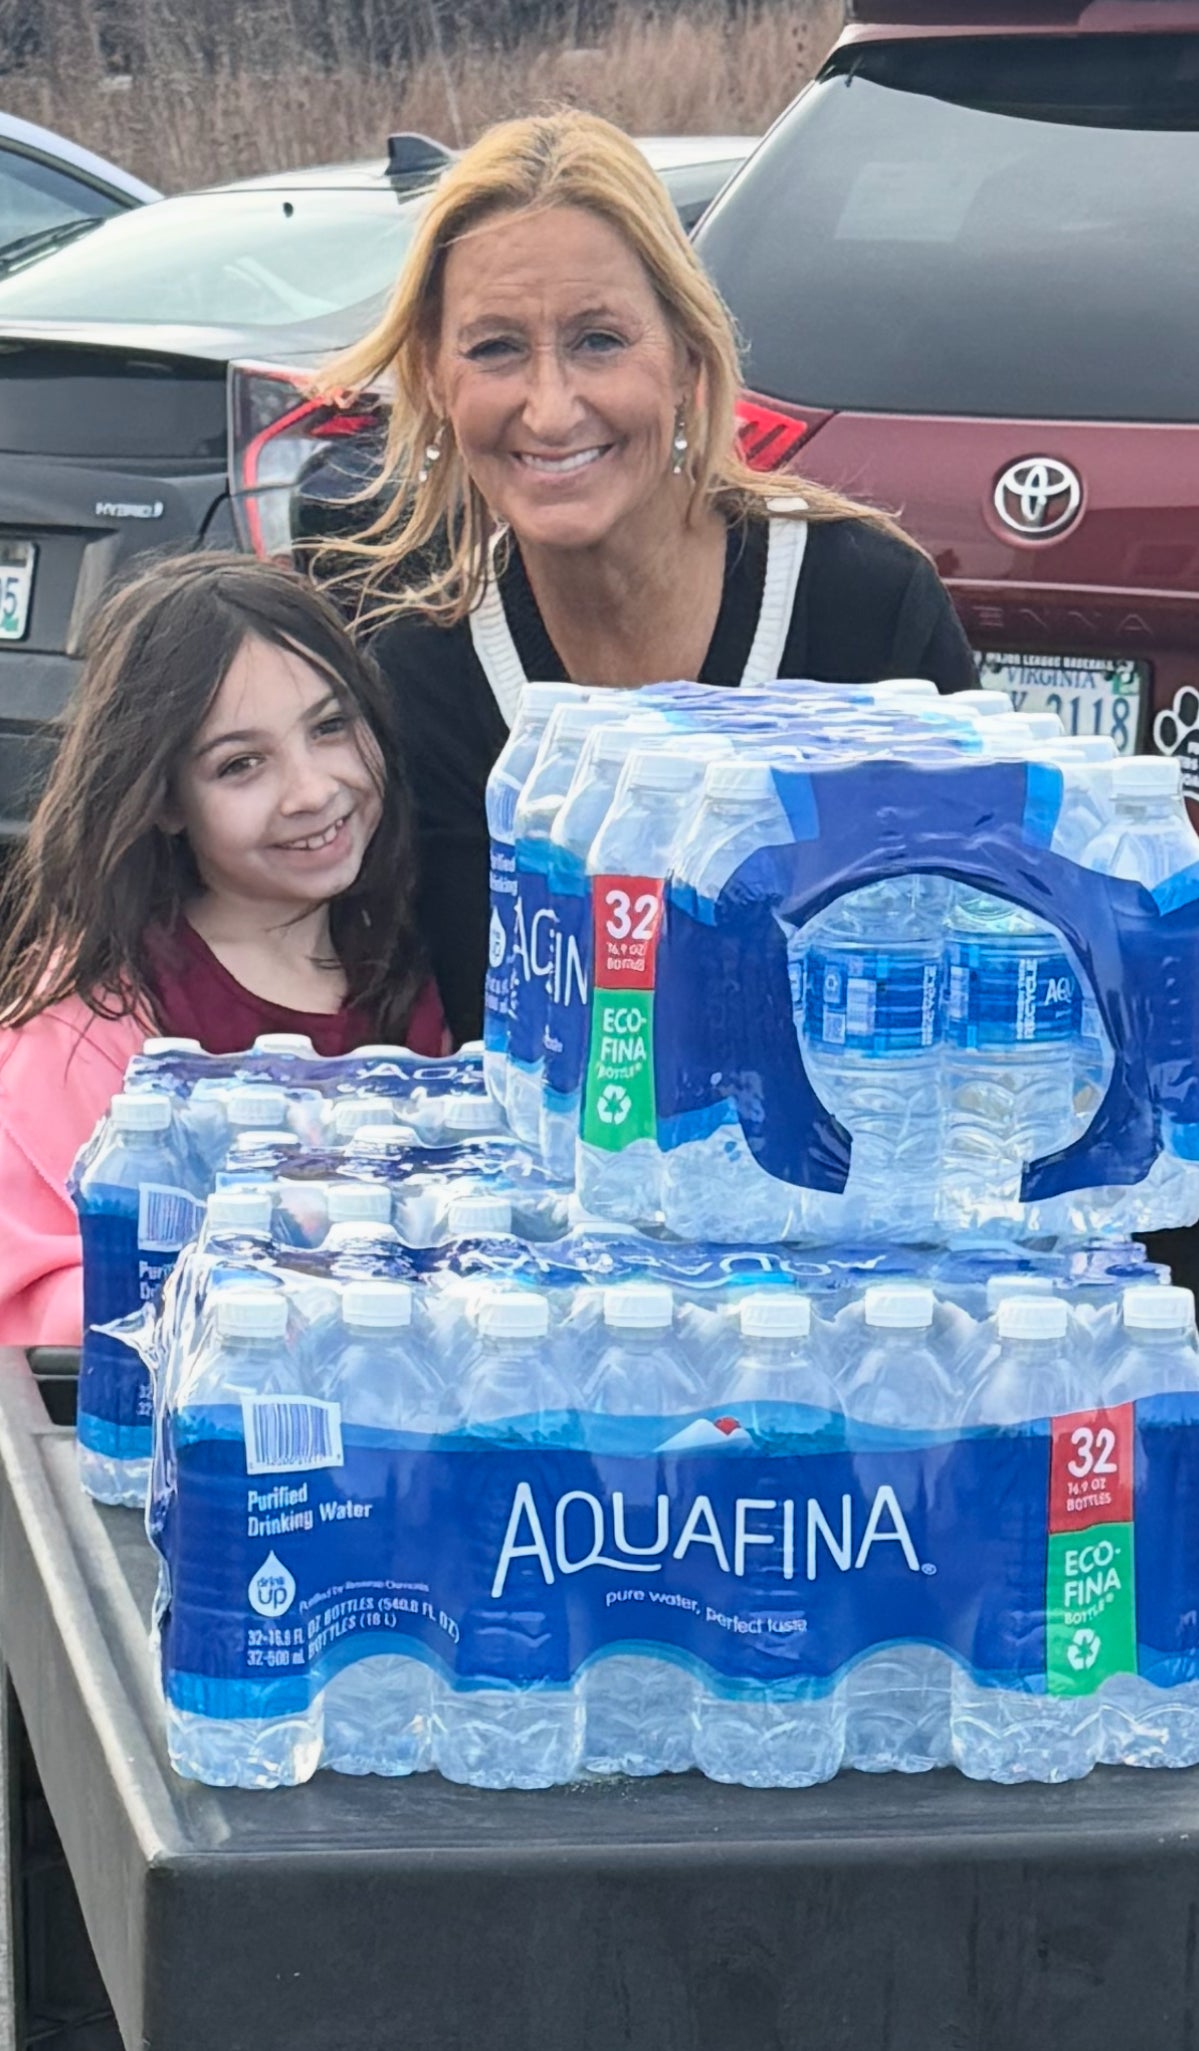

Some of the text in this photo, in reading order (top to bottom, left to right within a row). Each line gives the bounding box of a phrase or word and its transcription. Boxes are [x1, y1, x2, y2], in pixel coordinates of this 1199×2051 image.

[1006, 666, 1097, 689] VIRGINIA
[605, 889, 659, 940] 32
[602, 1007, 647, 1034] ECO-
[599, 1035, 647, 1063] FINA
[1066, 1427, 1118, 1478] 32
[247, 1482, 308, 1513] Purified
[1066, 1492, 1112, 1512] BOTTLES
[247, 1500, 373, 1537] Drinking Water
[491, 1481, 921, 1598] AQUAFINA
[1064, 1540, 1121, 1577] ECO-
[1064, 1567, 1122, 1607] FINA
[323, 1597, 374, 1620] BOTTLES
[421, 1600, 437, 1622] FL
[605, 1588, 644, 1607] pure
[648, 1590, 701, 1616] water,
[705, 1606, 763, 1635] perfect
[307, 1612, 357, 1661] BOTTLES
